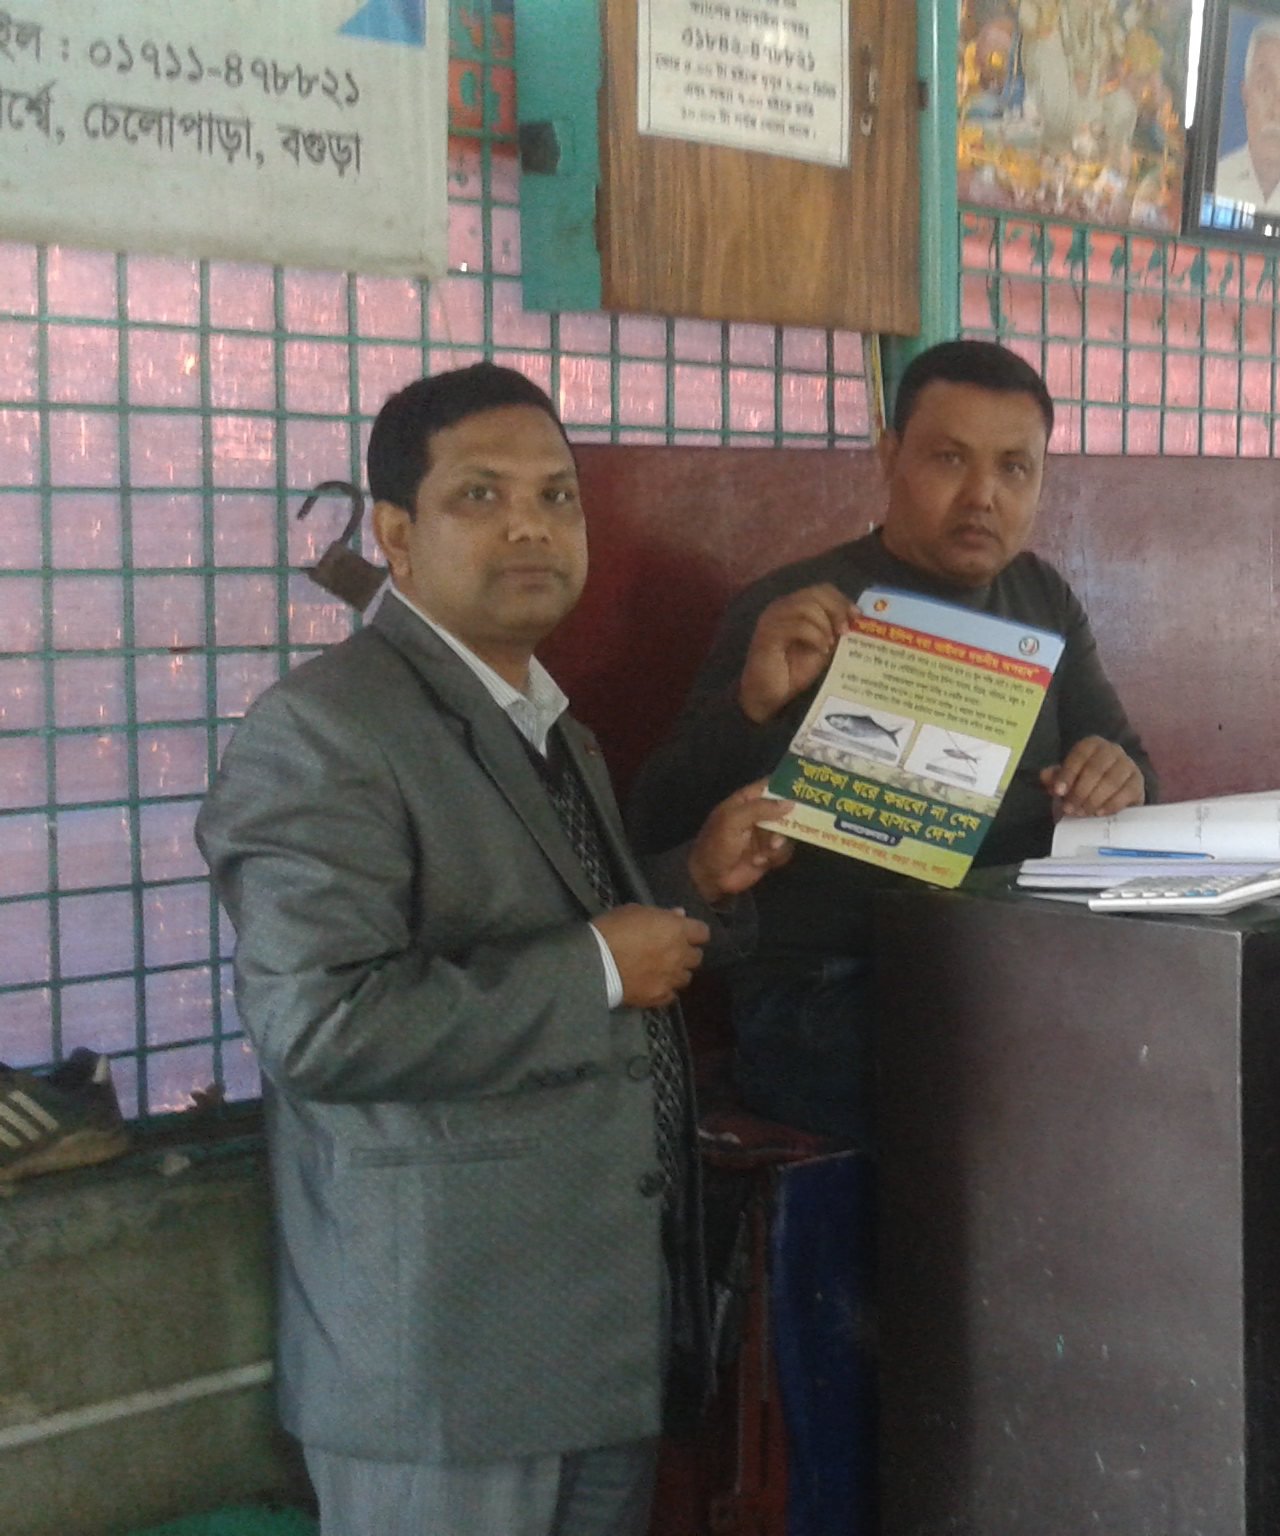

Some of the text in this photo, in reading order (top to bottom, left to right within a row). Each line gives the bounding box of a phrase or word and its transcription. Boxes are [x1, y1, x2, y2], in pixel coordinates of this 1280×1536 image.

[88, 33, 360, 110] ০১৭১১-৪৭৮৮২১
[84, 99, 265, 168] চেলোপাড়া,
[276, 122, 363, 178] বগুড়া
[792, 778, 835, 806] বাঁচবে
[836, 797, 876, 820] জেলে
[879, 812, 922, 835] হাসবে
[853, 781, 879, 800] ধরে
[883, 791, 928, 816] করবো
[930, 805, 948, 822] না
[950, 811, 980, 830] শেষ
